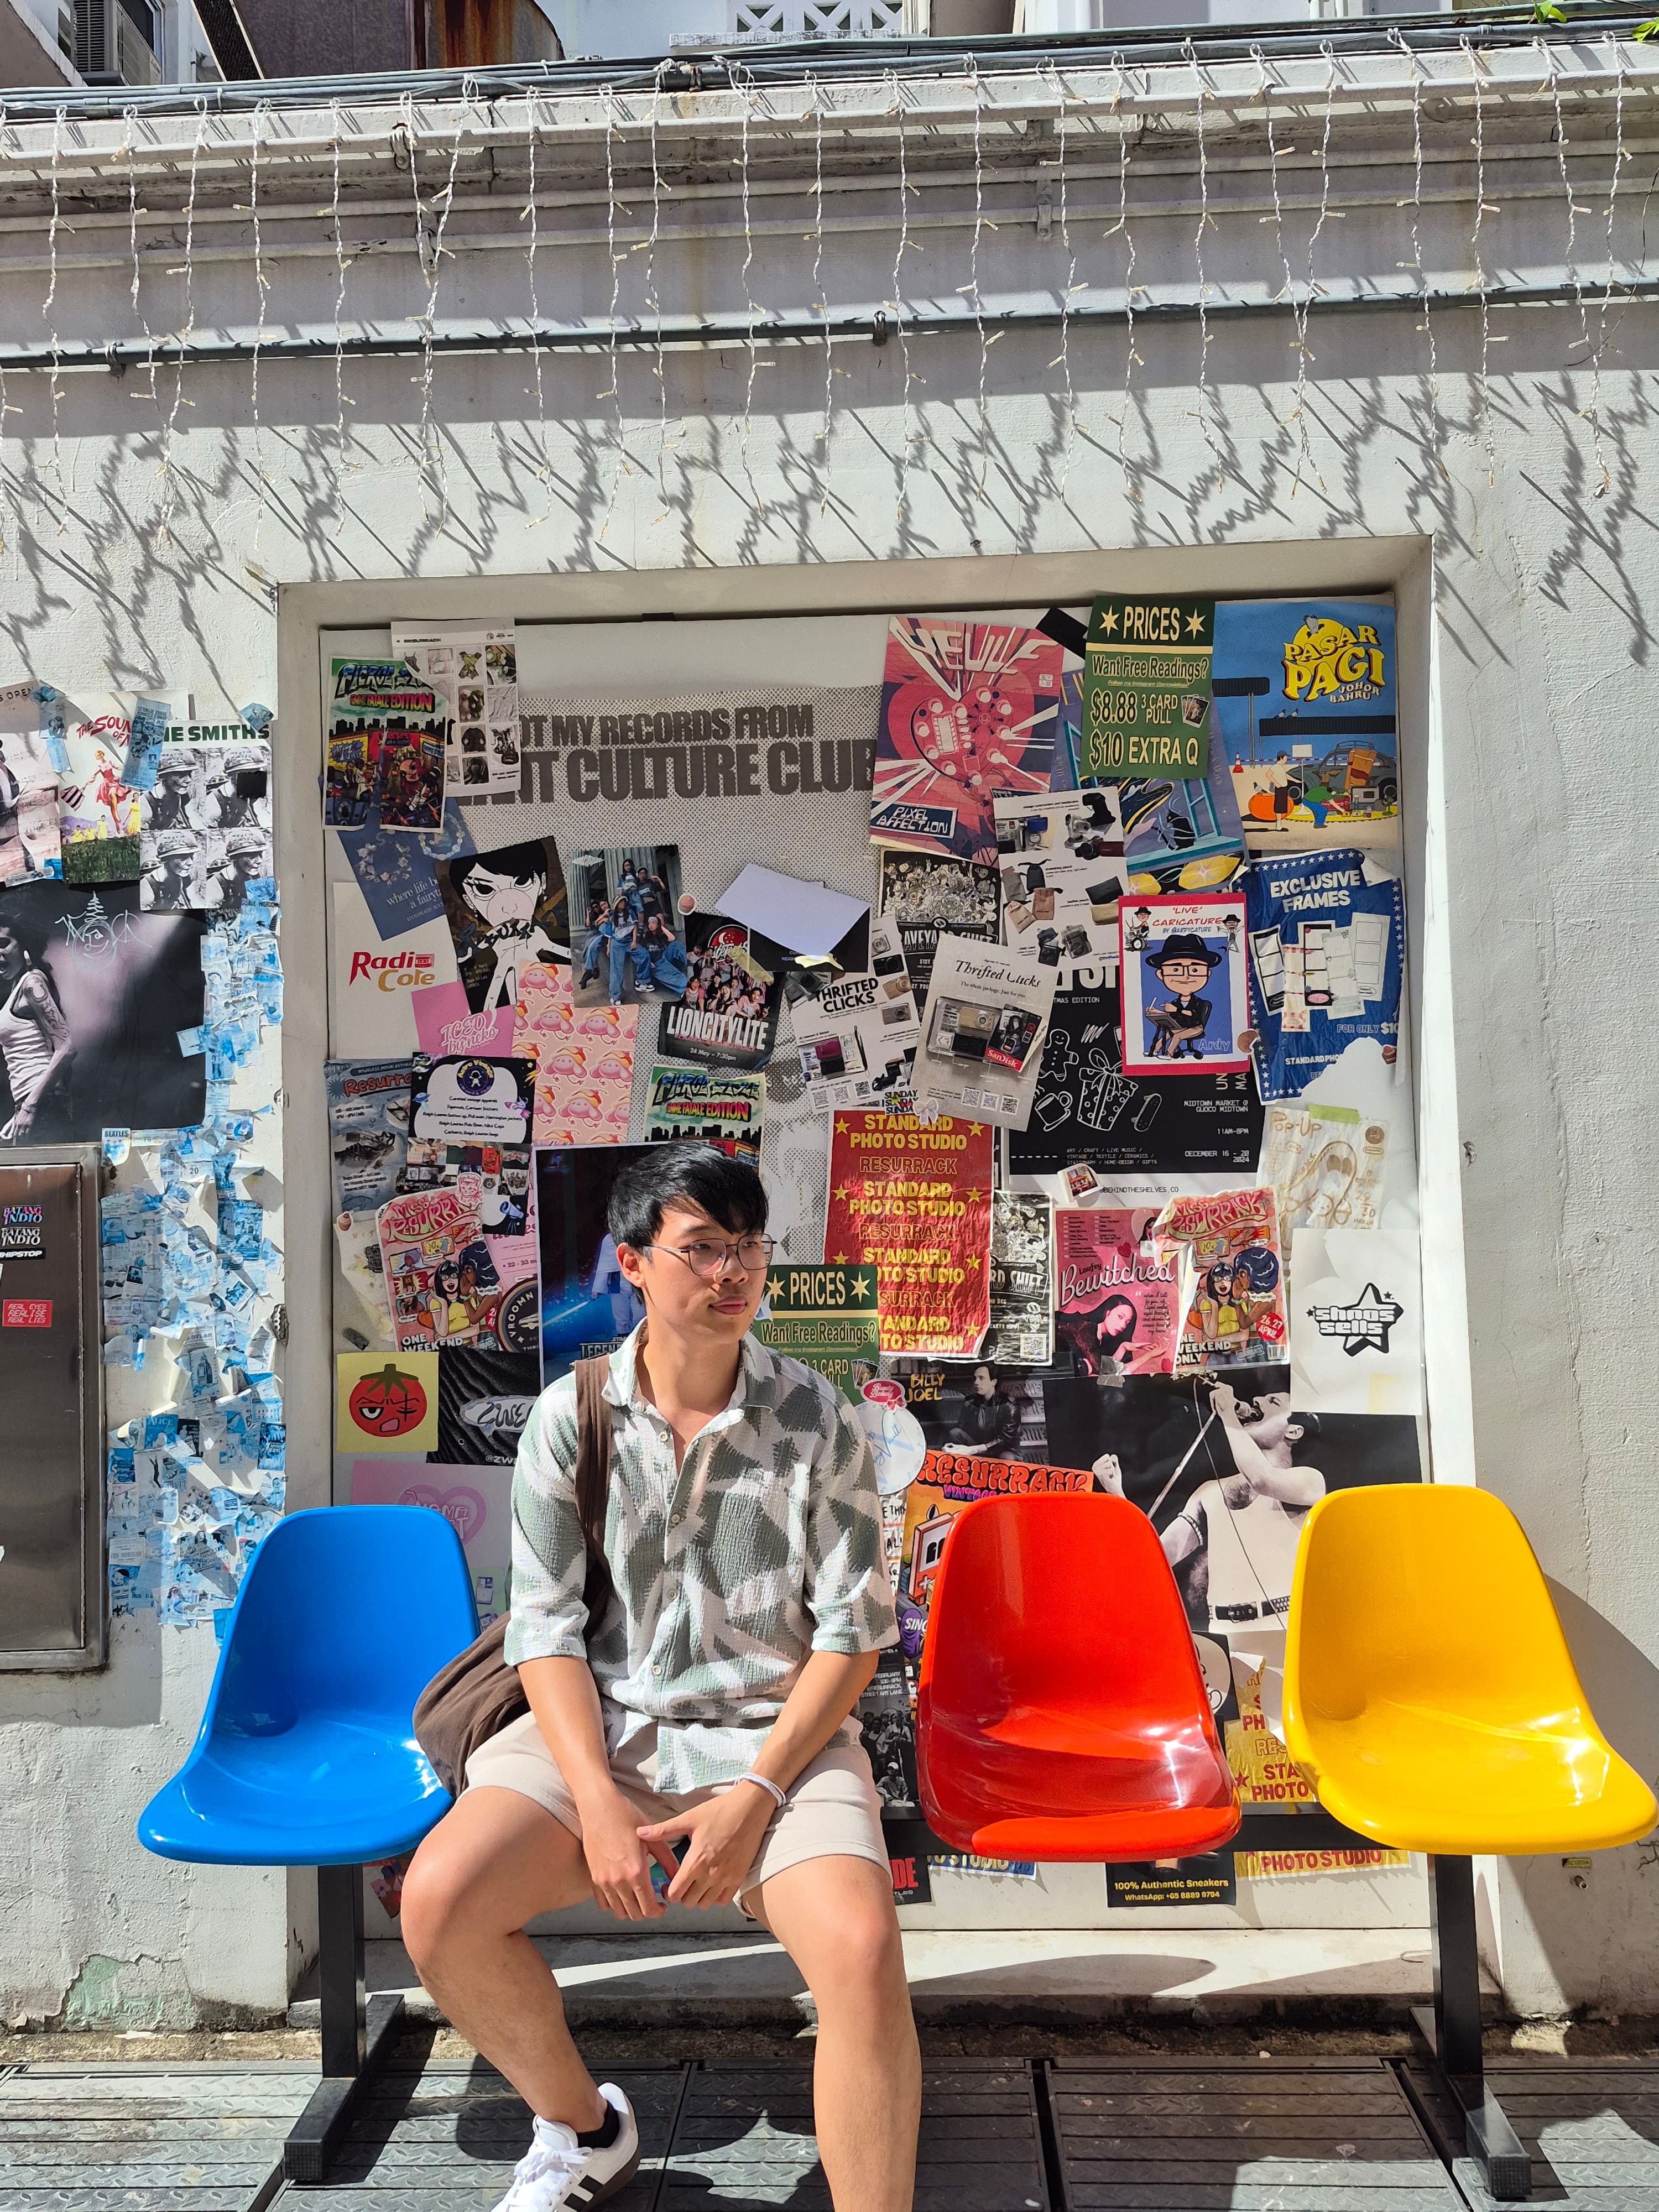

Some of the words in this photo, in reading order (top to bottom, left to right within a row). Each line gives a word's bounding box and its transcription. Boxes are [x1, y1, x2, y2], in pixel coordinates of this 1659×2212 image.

[1123, 606, 1181, 641] PRICES
[1283, 625, 1382, 661] PASAR
[1092, 655, 1122, 677] Want
[1122, 655, 1147, 677] Free
[1149, 656, 1209, 684] Readings?
[1281, 646, 1386, 702] PAGI
[1329, 691, 1371, 703] BAHRU
[1338, 681, 1381, 696] JOHOR
[390, 693, 435, 713] EDITION
[1091, 688, 1138, 726] $8.88
[1141, 694, 1146, 709] 3
[1149, 693, 1178, 709] CARD
[551, 715, 595, 746] MY
[601, 708, 731, 745] RECORDS
[735, 705, 813, 740] FROM
[1146, 709, 1172, 724] PULL
[76, 721, 93, 739] THE
[112, 731, 123, 740] OF
[189, 724, 270, 742] SMITHS
[1089, 728, 1124, 771] $10
[1128, 737, 1182, 765] EXTRA
[1186, 737, 1199, 766] Q
[566, 744, 764, 802] CULTURE
[768, 739, 877, 796] CLUB
[892, 806, 929, 822] PIXEL
[876, 815, 948, 834] AFFECTION
[386, 889, 414, 906] where
[413, 880, 428, 894] life
[1270, 870, 1361, 899] EXCLUSIVE
[1172, 906, 1203, 915] 'LIVE'
[1283, 890, 1351, 913] FRAMES
[1152, 917, 1223, 926] CARICATURE
[378, 969, 436, 992] Cole
[955, 960, 1004, 983] Thrifted
[815, 978, 879, 1003] THRIFTED
[823, 992, 875, 1013] CLICKS
[666, 1005, 769, 1051] LIONCITYLITE
[1337, 1024, 1354, 1033] FOR
[1357, 1024, 1380, 1034] ONLY
[1198, 1038, 1231, 1053] Ardy
[987, 1049, 1019, 1068] SanDisk
[1285, 1055, 1325, 1065] STANDARD
[457, 1062, 473, 1079] Astro
[885, 1089, 918, 1099] SUNDAY
[706, 1101, 751, 1122] EDITION
[1269, 1110, 1323, 1139] Pop-Up
[850, 1133, 904, 1150] PHOTO
[907, 1133, 968, 1150] STUDIO
[859, 1157, 957, 1175] RESURRACK
[863, 1181, 953, 1197] STANDARD
[4, 1206, 42, 1217] BATANG
[849, 1201, 903, 1217] PHOTO
[907, 1200, 966, 1217] STUDIO
[1, 1227, 40, 1239] BATANG
[859, 1223, 956, 1241] RESURRACK
[863, 1248, 952, 1265] STANDARD
[906, 1267, 966, 1284] STUDIO
[1078, 1263, 1103, 1275] Laufey
[790, 1271, 846, 1305] PRICES
[1009, 1270, 1044, 1295] SHIFT
[1060, 1252, 1176, 1308] Bewitched
[879, 1290, 955, 1307] SURRACK
[507, 1291, 535, 1338] VROOMN
[762, 1322, 790, 1344] Want
[791, 1323, 817, 1344] Free
[818, 1322, 876, 1348] Readings?
[1258, 1324, 1276, 1338] APRIL
[1319, 1319, 1384, 1334] sells
[401, 1333, 427, 1346] ONE
[403, 1337, 463, 1353] WEEKEND
[906, 1334, 963, 1350] STUDIO
[820, 1358, 849, 1375] CARD
[910, 1374, 946, 1387] BILLY
[907, 1389, 943, 1403] JOEL
[147, 1417, 174, 1426] ALICE
[917, 1452, 1089, 1493] RESURRACK
[1262, 1762, 1300, 1781] STA
[1251, 1781, 1309, 1802] PHOTO
[1260, 1852, 1318, 1872] PHOTO
[1321, 1850, 1382, 1868] STUDIO
[1114, 1881, 1140, 1890] 100%
[1141, 1880, 1185, 1890] Authentic
[1186, 1878, 1229, 1888] Sneakers
